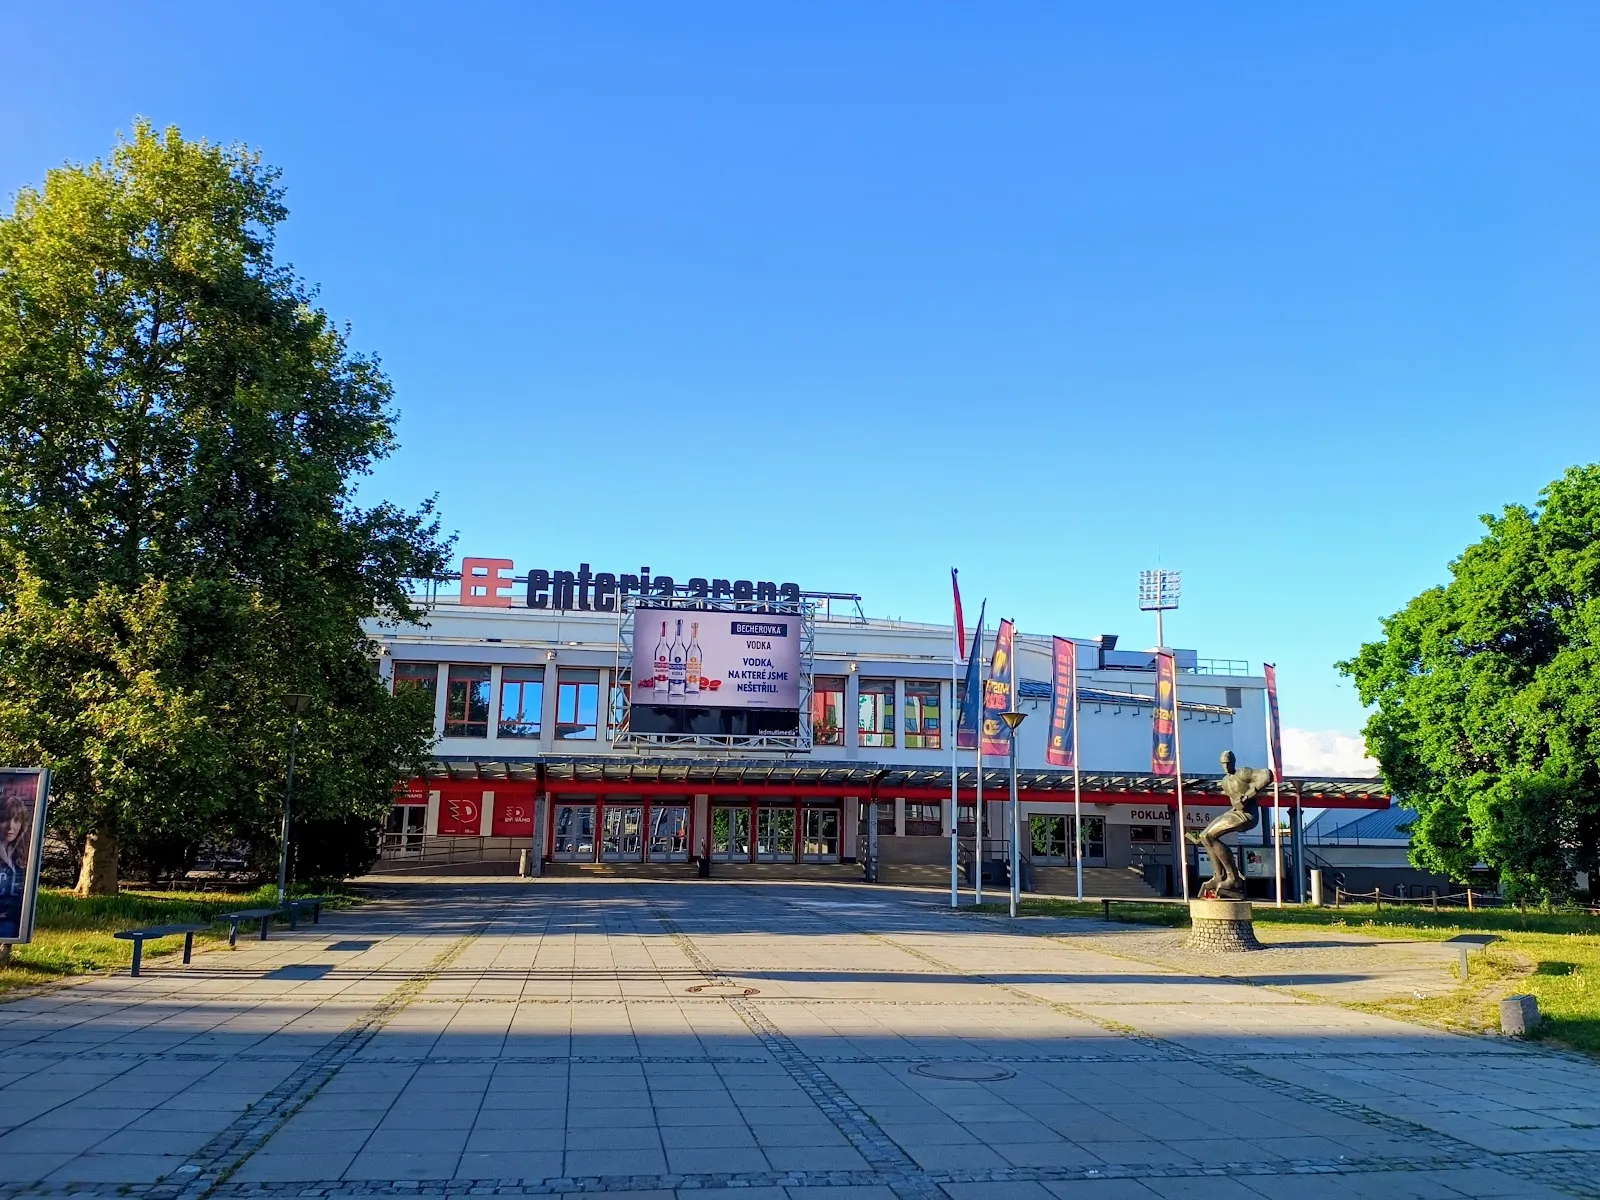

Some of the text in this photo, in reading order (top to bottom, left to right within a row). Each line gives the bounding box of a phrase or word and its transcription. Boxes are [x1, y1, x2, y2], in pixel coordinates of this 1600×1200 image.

[526, 563, 801, 614] enteria arena
[736, 623, 782, 635] BECHEROVKA
[746, 640, 772, 650] VODKA
[743, 657, 775, 669] VODKA,
[728, 669, 789, 681] NA KTERÉ JSME
[737, 681, 779, 693] NEŠETŘILI.
[1205, 813, 1210, 821] 6
